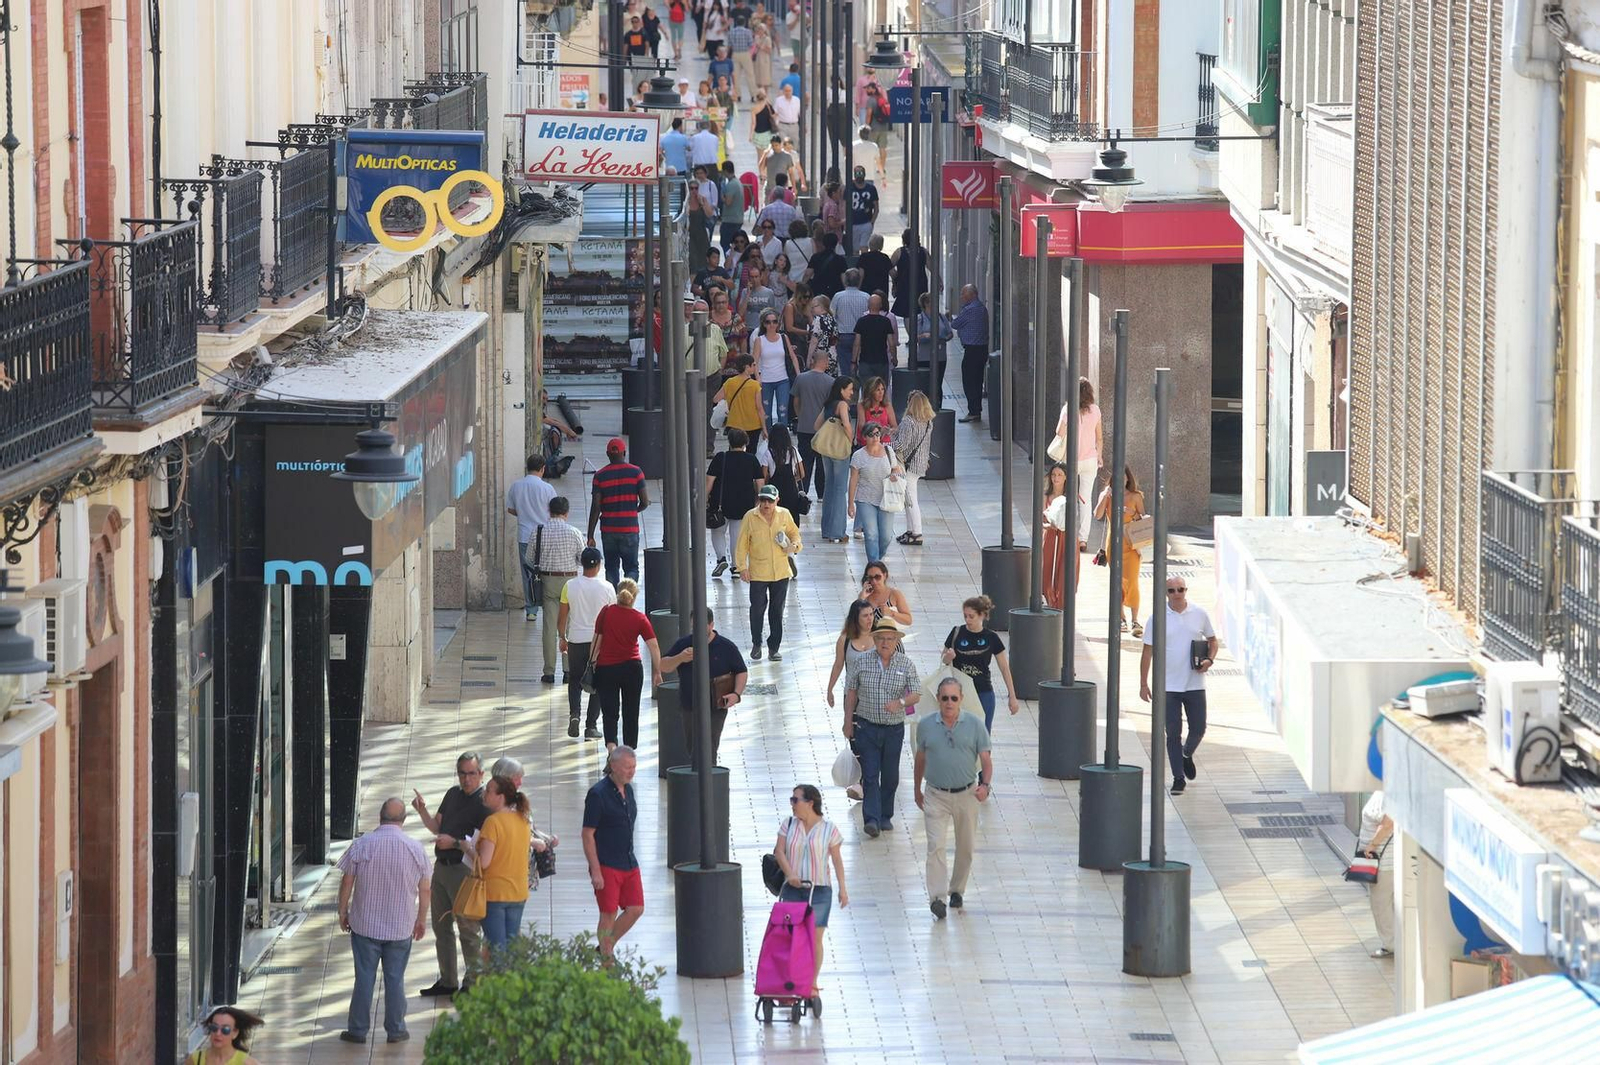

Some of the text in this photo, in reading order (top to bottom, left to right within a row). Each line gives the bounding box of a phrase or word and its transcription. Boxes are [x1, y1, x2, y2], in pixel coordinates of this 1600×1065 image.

[528, 145, 568, 173] La
[580, 241, 623, 251] KETAMA
[543, 306, 568, 316] TAMA
[582, 306, 624, 316] KETAMA
